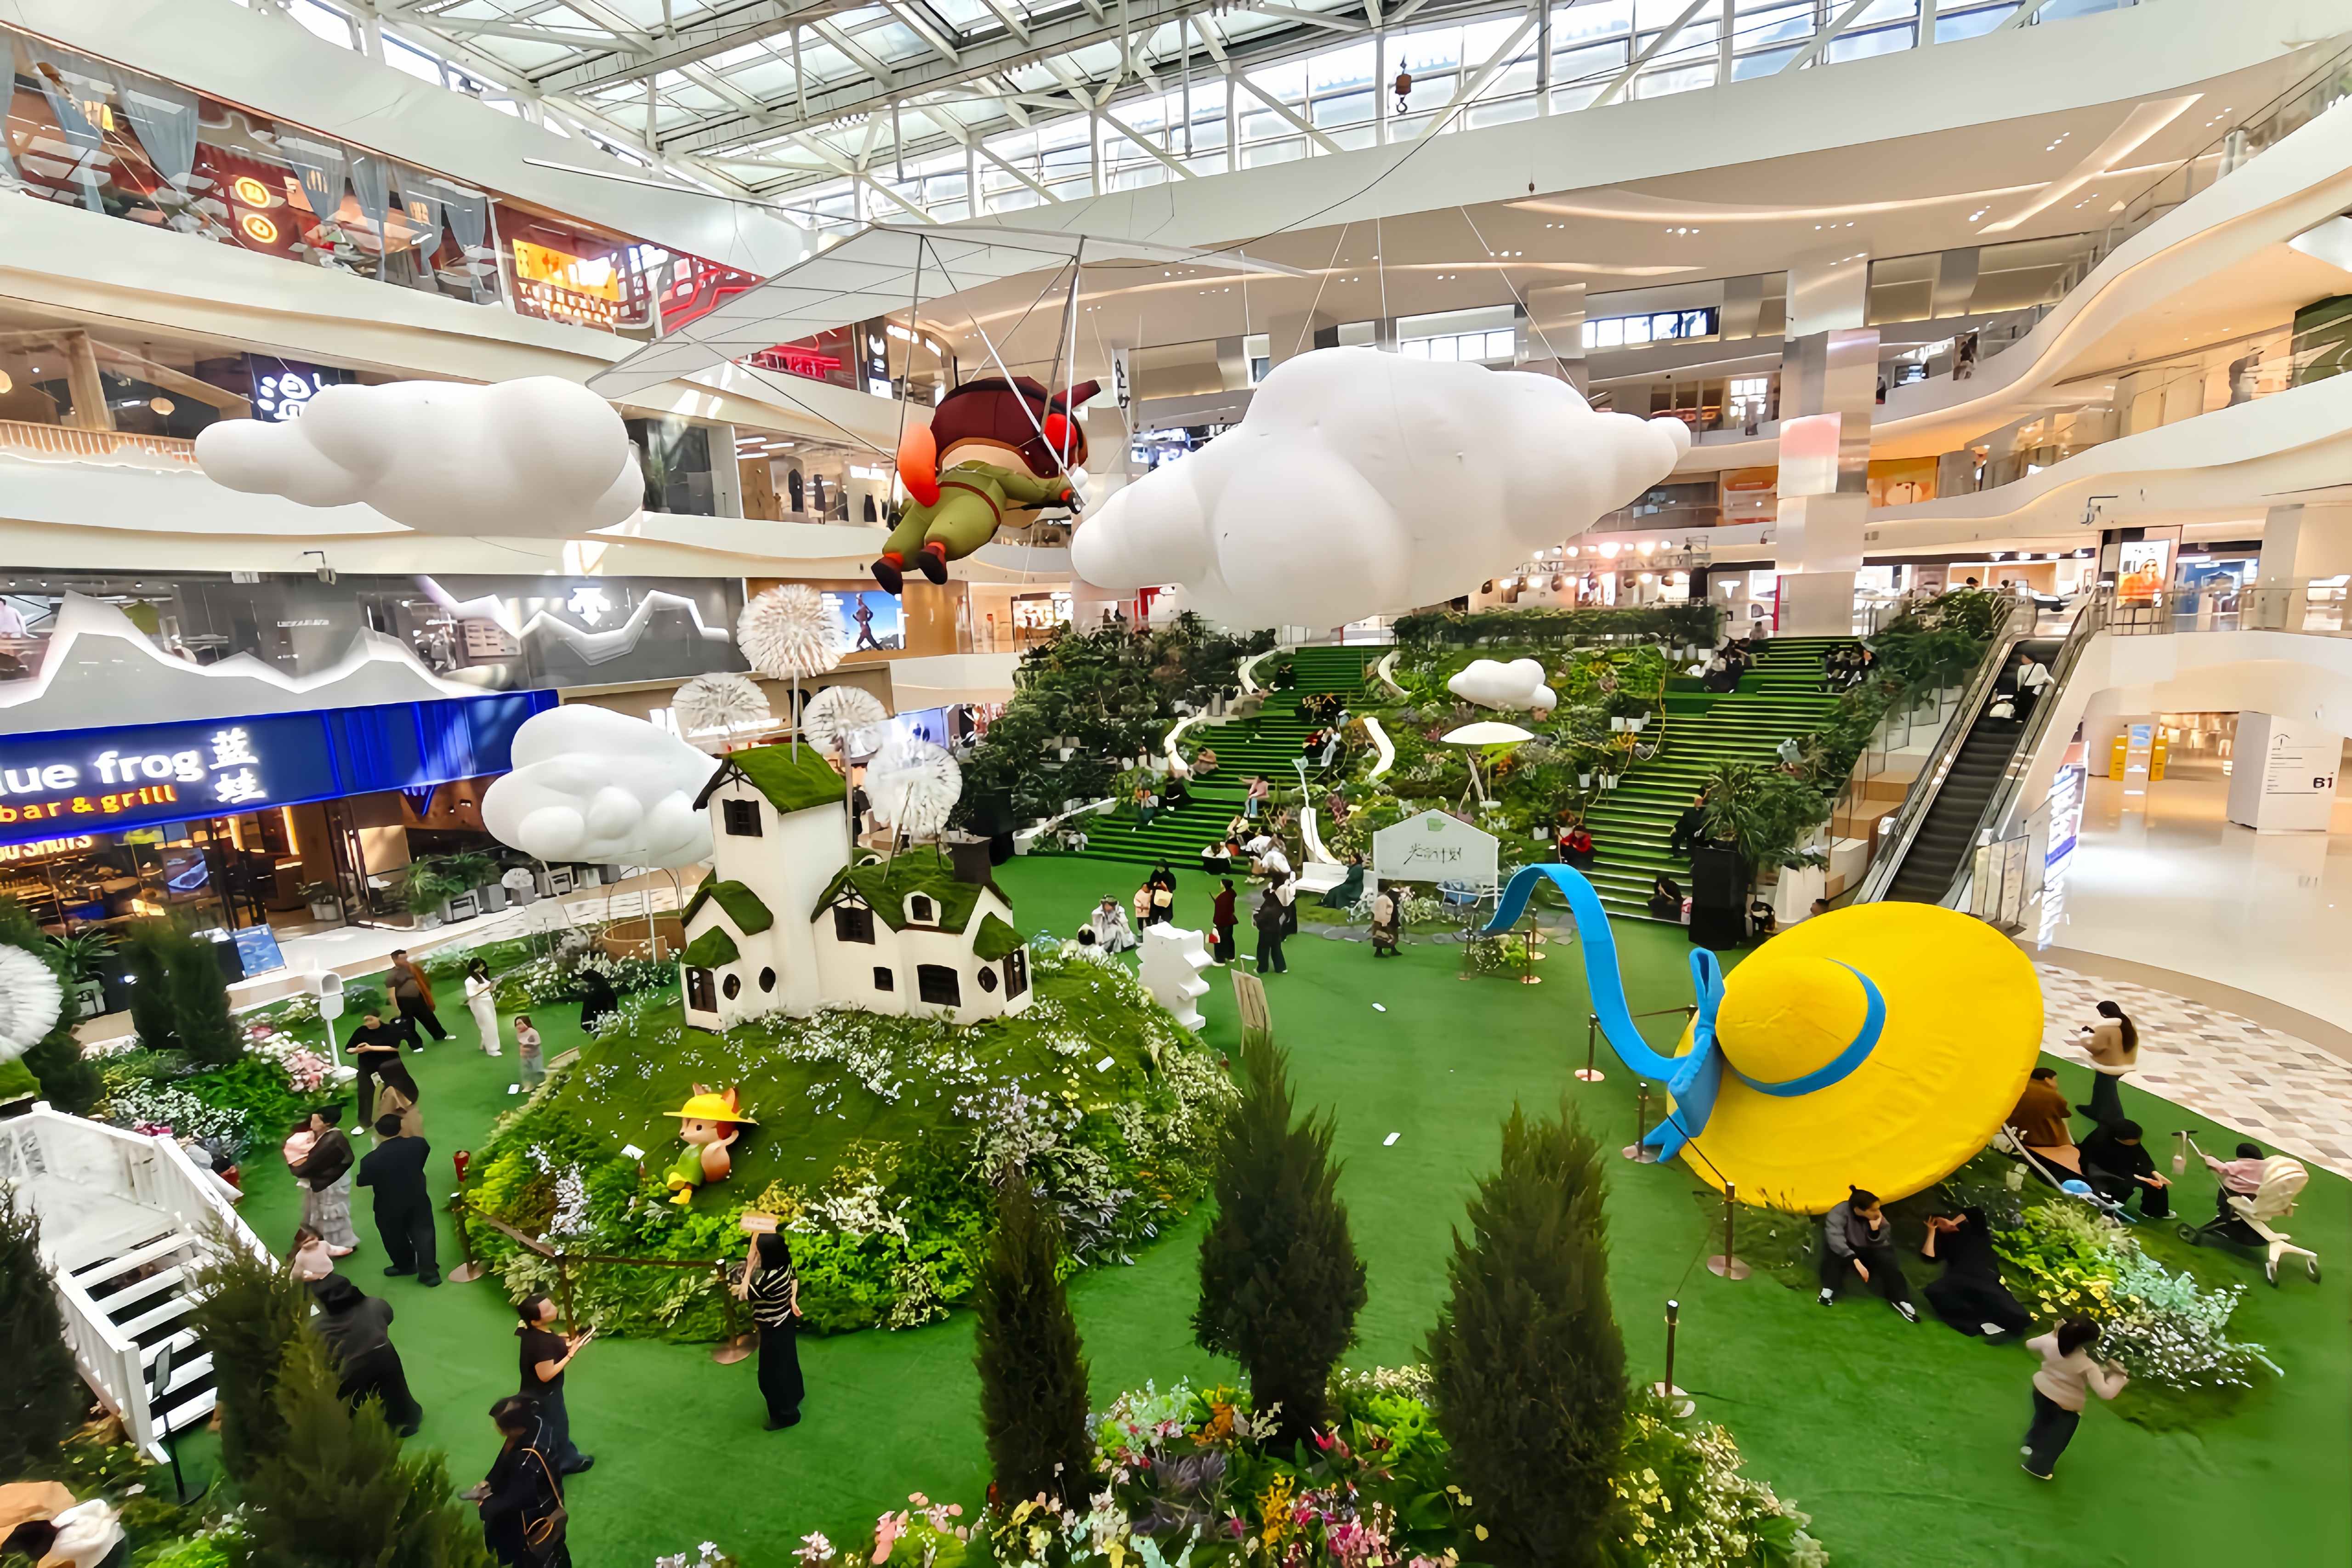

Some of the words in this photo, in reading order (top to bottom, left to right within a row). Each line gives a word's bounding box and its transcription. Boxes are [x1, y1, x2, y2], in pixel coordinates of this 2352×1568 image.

[94, 750, 204, 784] frog
[0, 802, 61, 822] bar
[71, 797, 95, 813] &
[101, 784, 177, 813] grill
